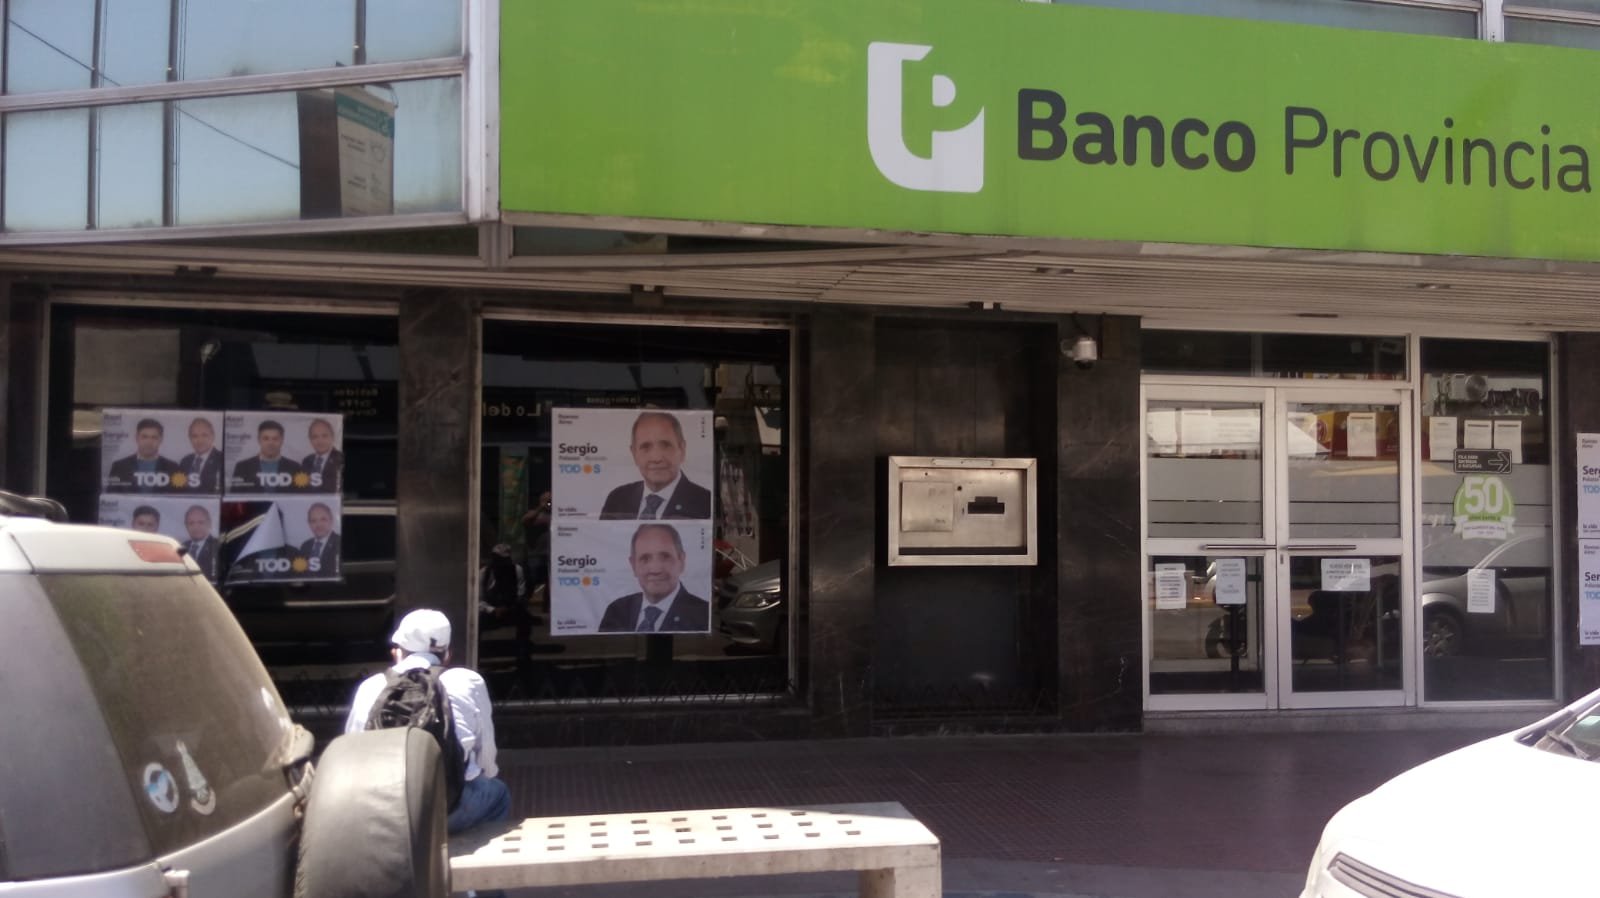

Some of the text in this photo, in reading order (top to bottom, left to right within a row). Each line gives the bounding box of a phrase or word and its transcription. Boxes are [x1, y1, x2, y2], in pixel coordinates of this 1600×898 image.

[1017, 87, 1592, 194] Banco Provincia
[559, 442, 598, 457] Sergio
[1582, 465, 1600, 478] Ser
[1464, 476, 1504, 514] 50
[557, 554, 597, 569] Sergio
